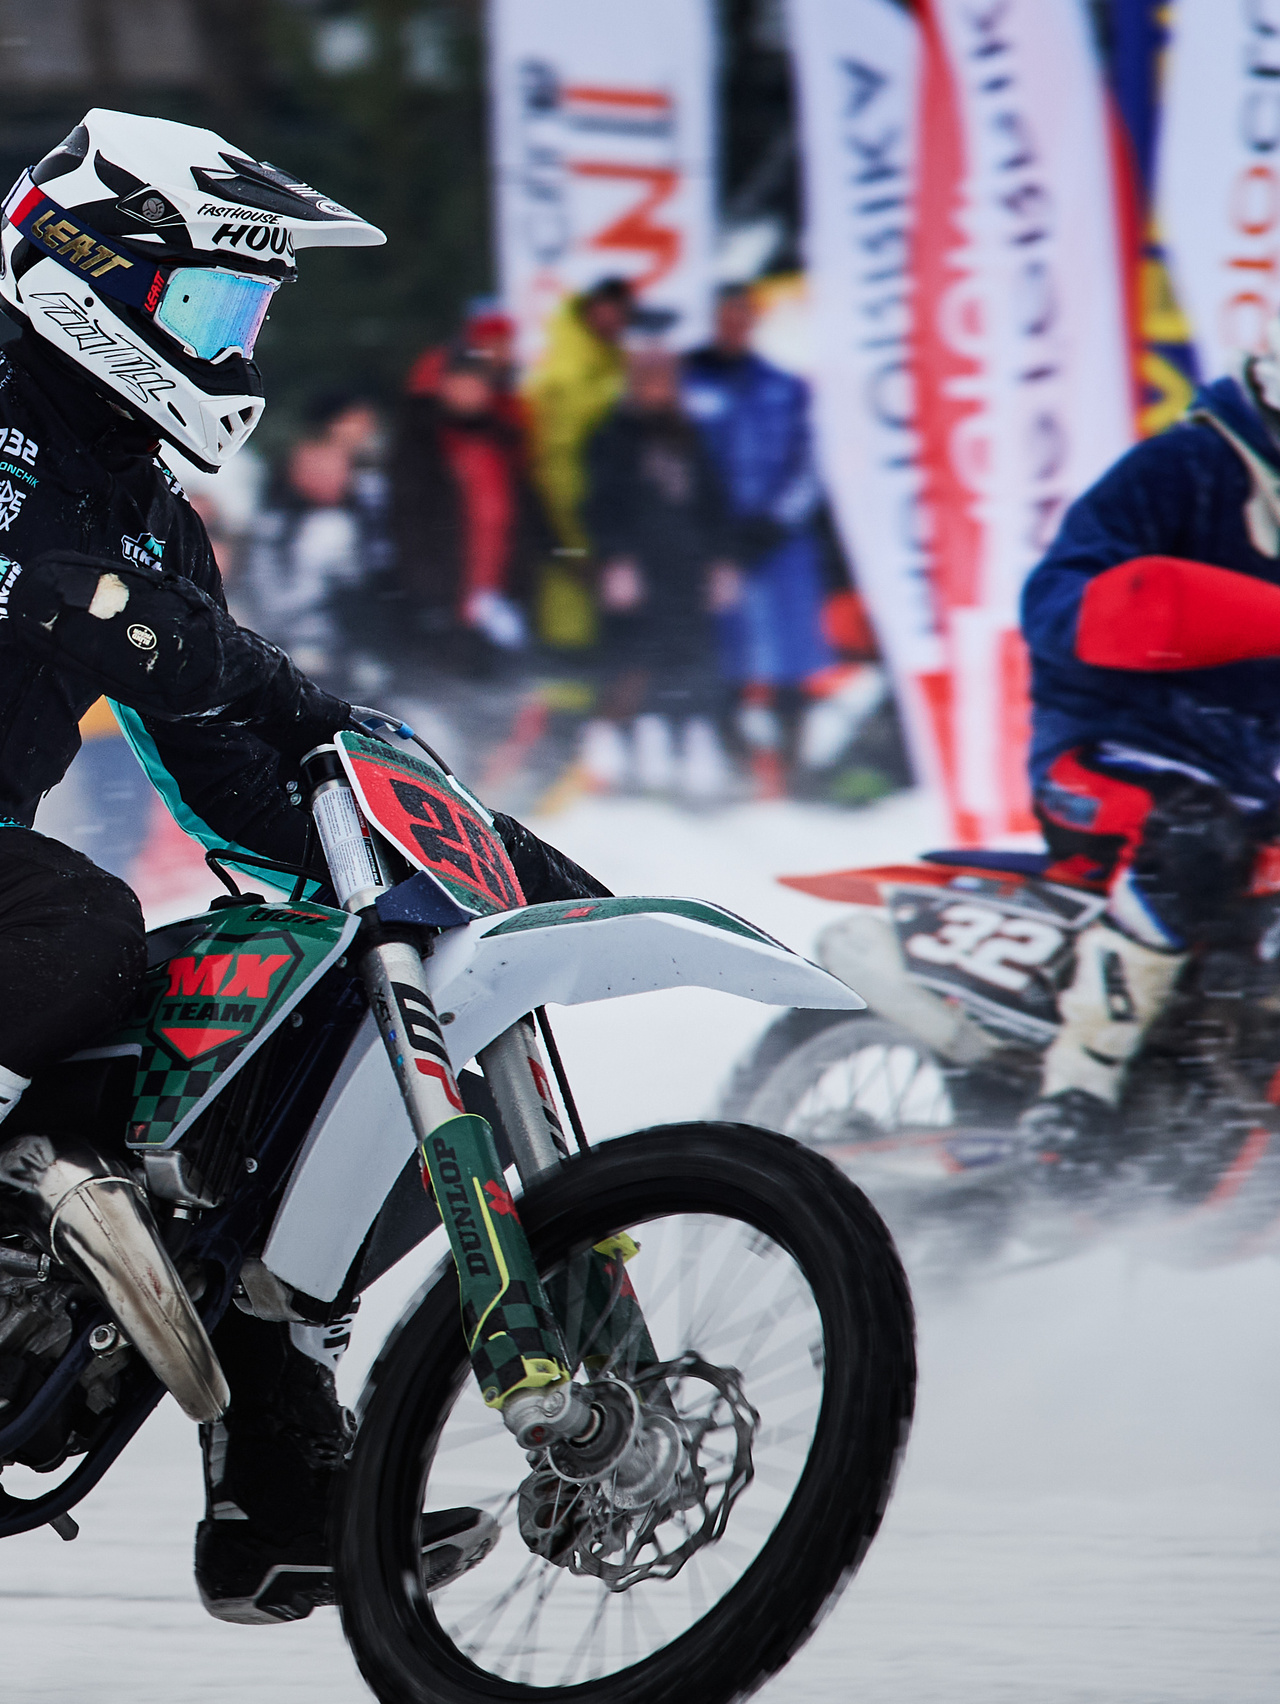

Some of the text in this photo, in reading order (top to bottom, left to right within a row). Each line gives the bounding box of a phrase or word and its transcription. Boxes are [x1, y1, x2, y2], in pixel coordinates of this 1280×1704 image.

[31, 209, 134, 278] LEATT
[144, 270, 166, 313] LEATT
[165, 953, 294, 998] MX
[906, 902, 1064, 992] 32
[160, 1002, 258, 1023] TEAM
[432, 1137, 492, 1277] DUNLOP
